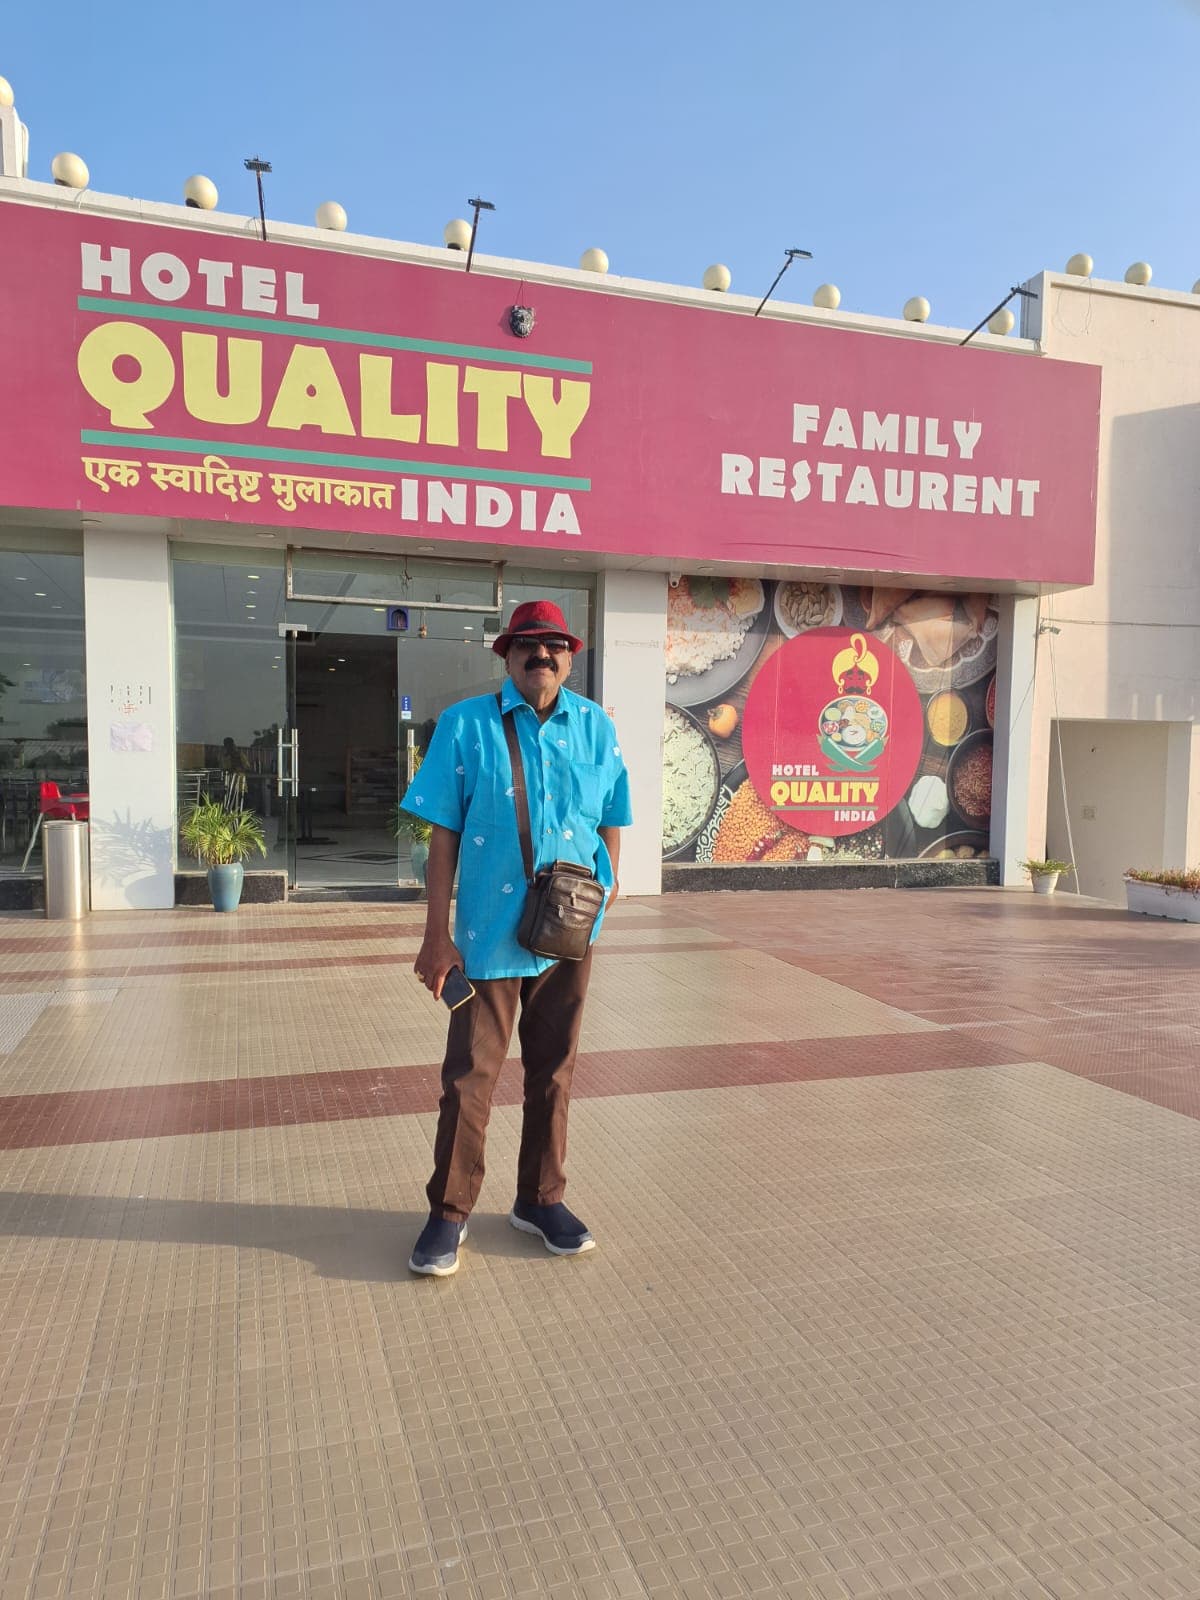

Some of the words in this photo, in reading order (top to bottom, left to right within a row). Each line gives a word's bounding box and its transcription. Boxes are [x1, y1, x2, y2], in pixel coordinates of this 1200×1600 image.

[80, 242, 320, 320] HOTEL
[77, 321, 592, 459] QUALITY
[792, 402, 982, 460] FAMILY
[80, 456, 142, 493] एक
[146, 455, 264, 503] स्वादिष्ट
[268, 472, 396, 512] मुलाकात
[401, 478, 582, 536] INDIA
[720, 452, 1041, 518] RESTAURENT
[770, 780, 880, 806] QUALITY
[772, 764, 820, 777] HOTEL
[834, 809, 877, 822] INDIA
